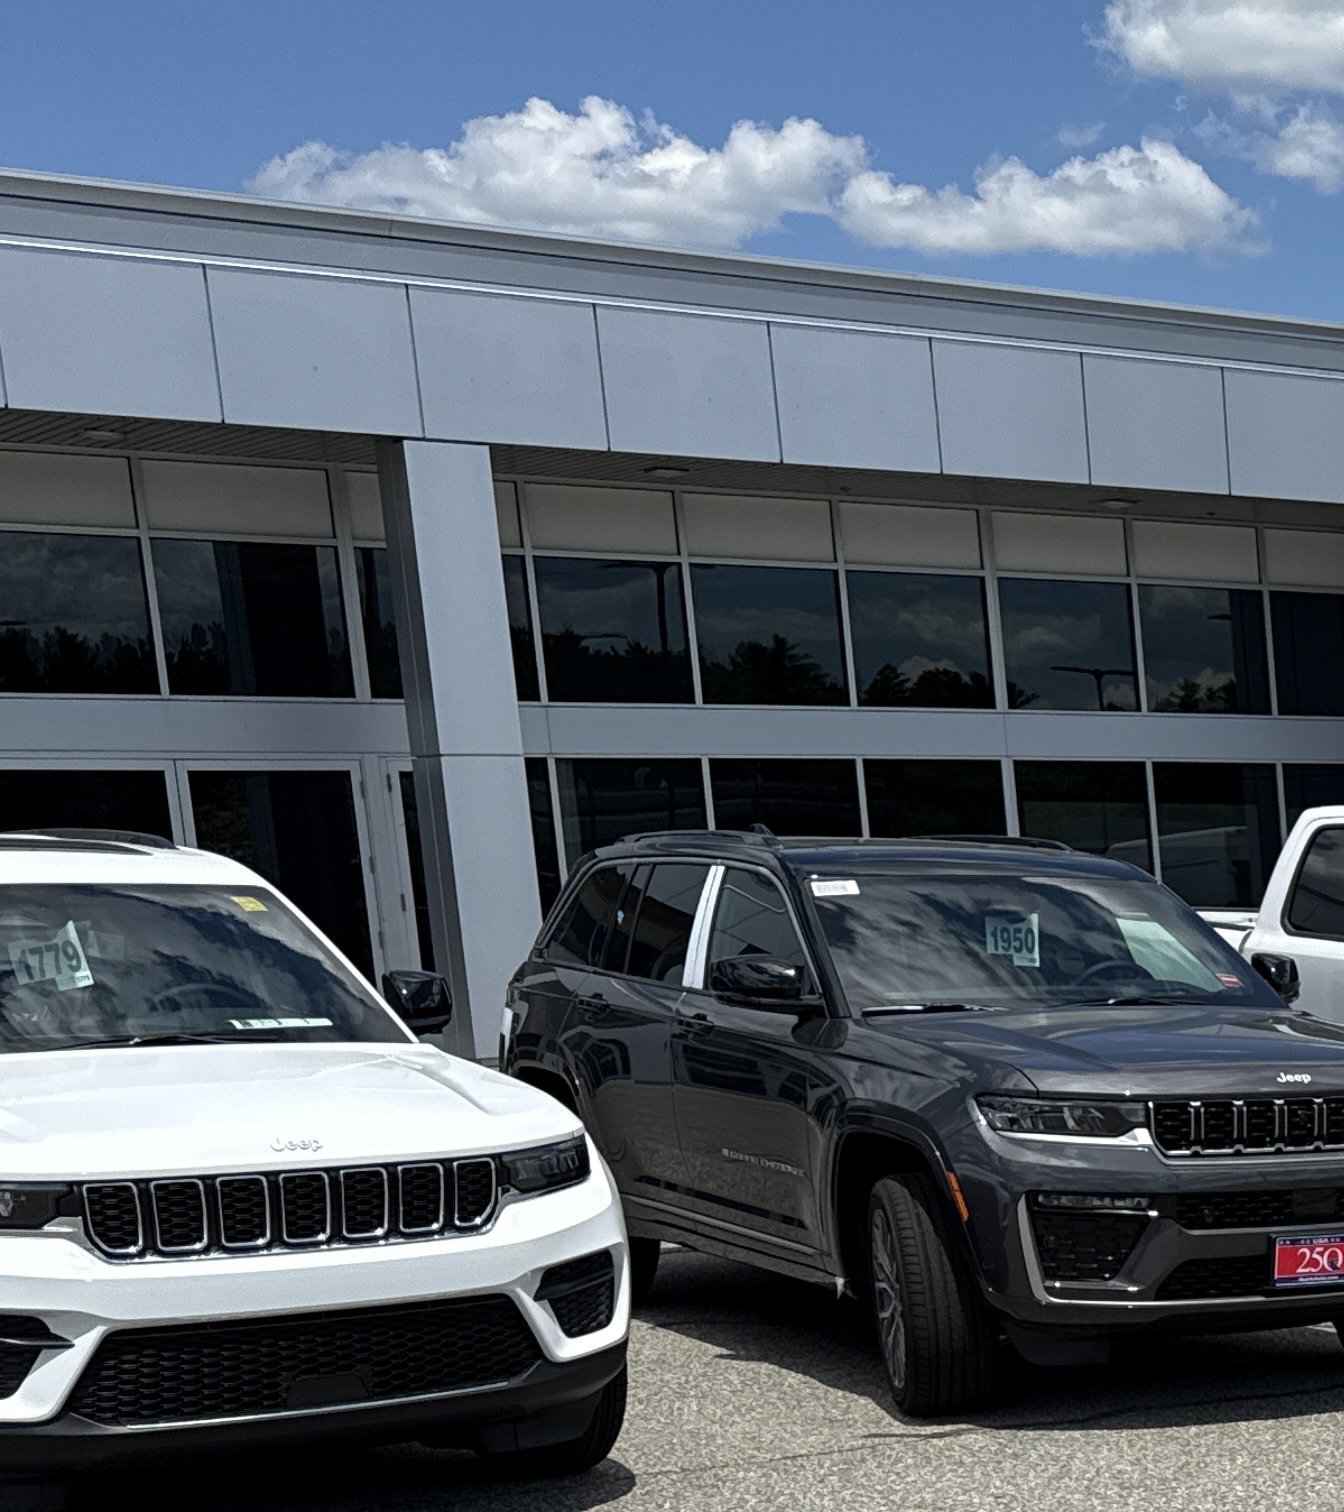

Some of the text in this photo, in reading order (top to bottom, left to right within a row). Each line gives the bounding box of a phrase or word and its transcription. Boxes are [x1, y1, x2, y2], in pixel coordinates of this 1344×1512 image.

[990, 926, 1036, 954] 1950
[18, 940, 82, 980] 1779
[1276, 1071, 1312, 1084] Jeep
[269, 1137, 323, 1153] Jeep
[1296, 1246, 1344, 1273] 250
